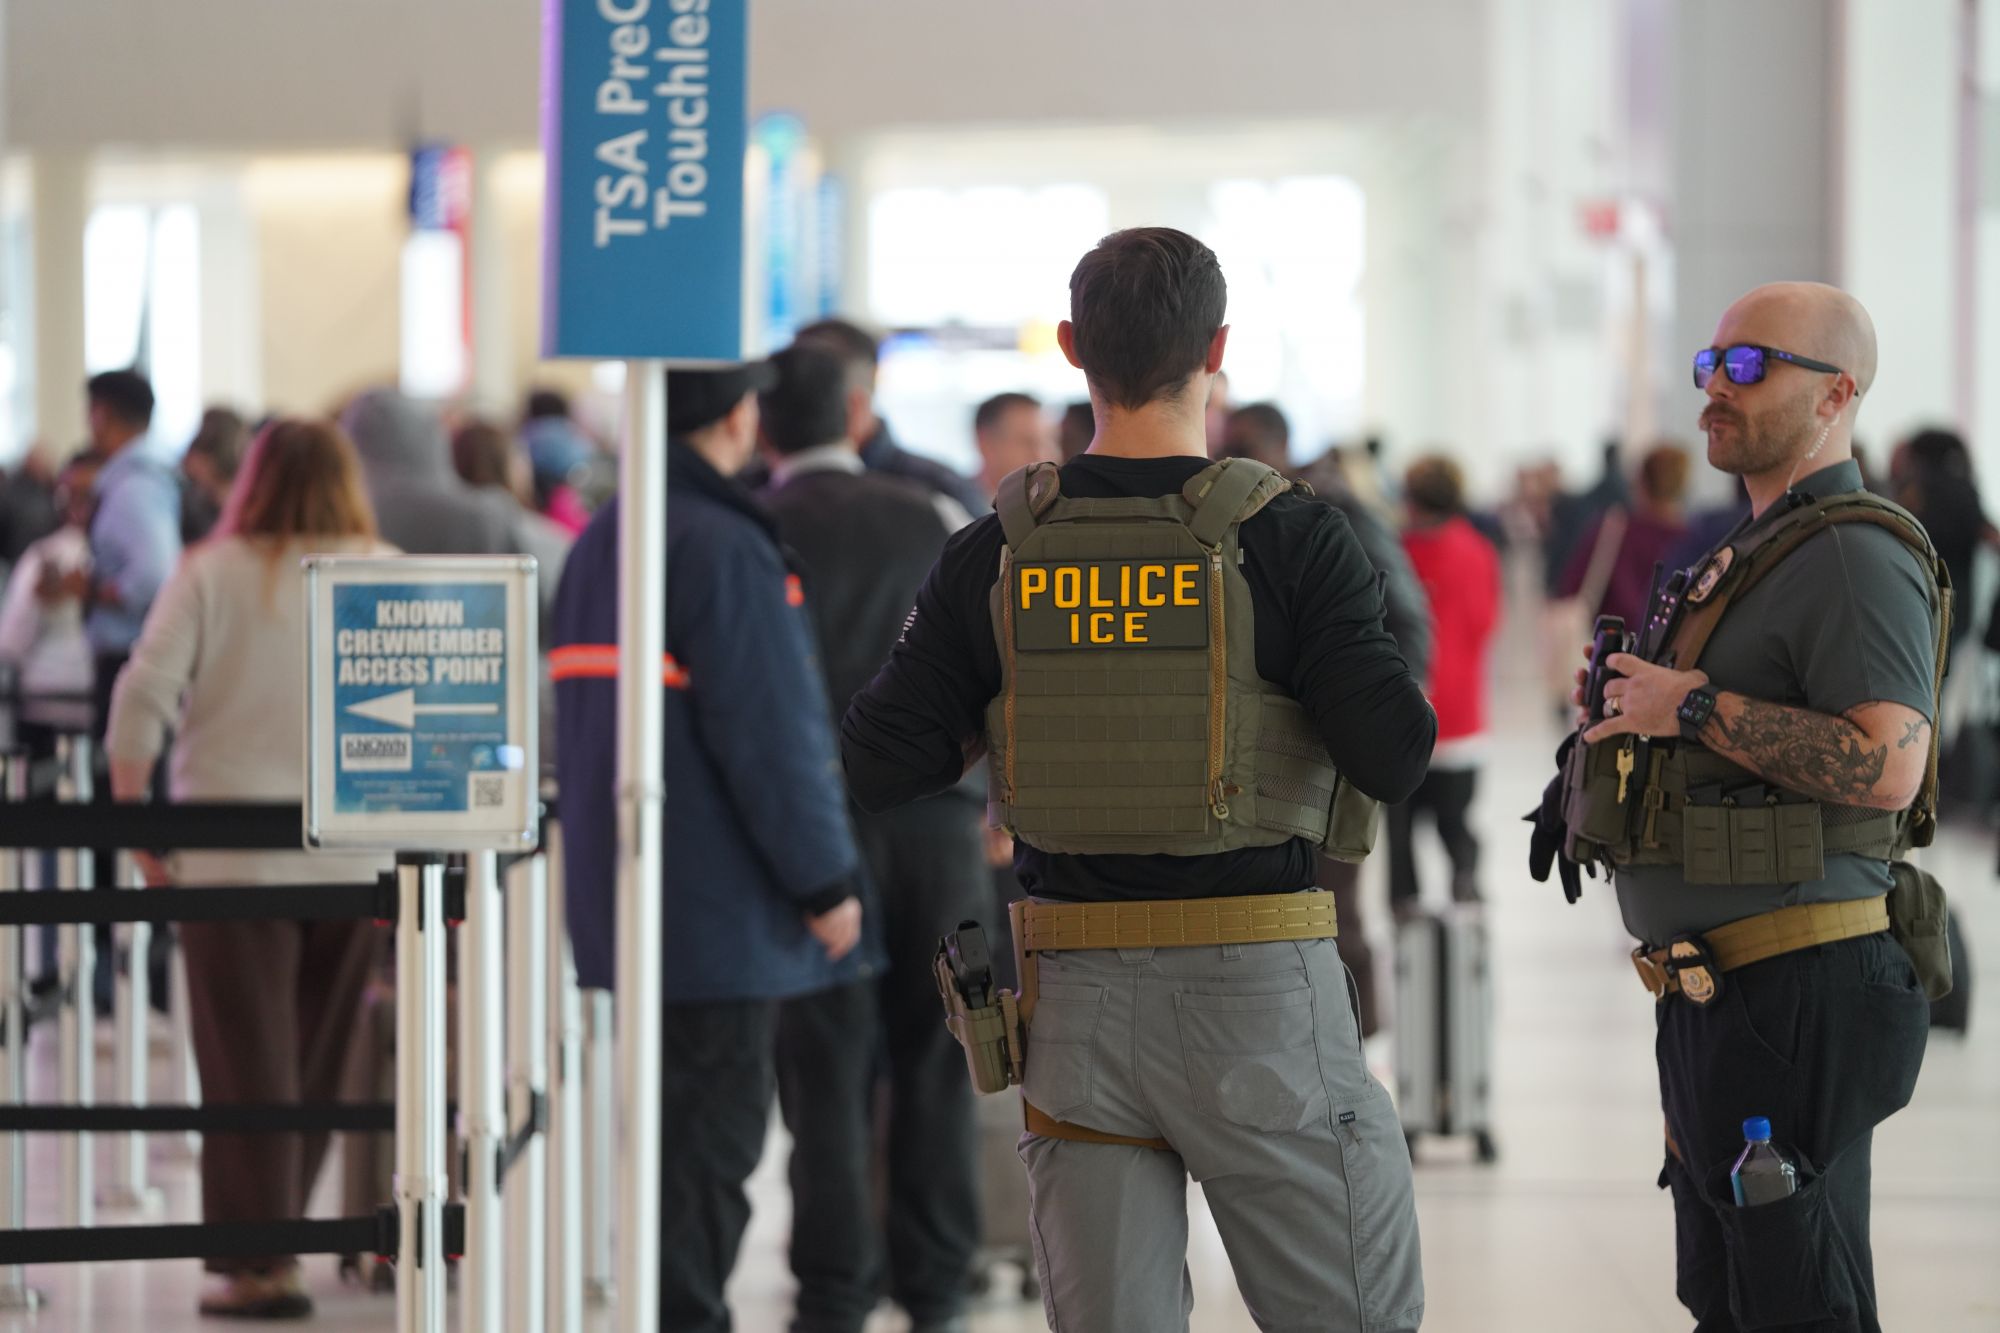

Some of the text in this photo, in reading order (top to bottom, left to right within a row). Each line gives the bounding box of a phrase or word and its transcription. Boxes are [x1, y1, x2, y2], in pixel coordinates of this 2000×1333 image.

[594, 129, 648, 247] TSA
[1020, 564, 1200, 609] POLICE
[376, 600, 464, 627] KNOWN
[1070, 612, 1149, 644] ICE
[338, 629, 504, 656] CREWMEMBER
[338, 657, 503, 685] ACCESS POINT
